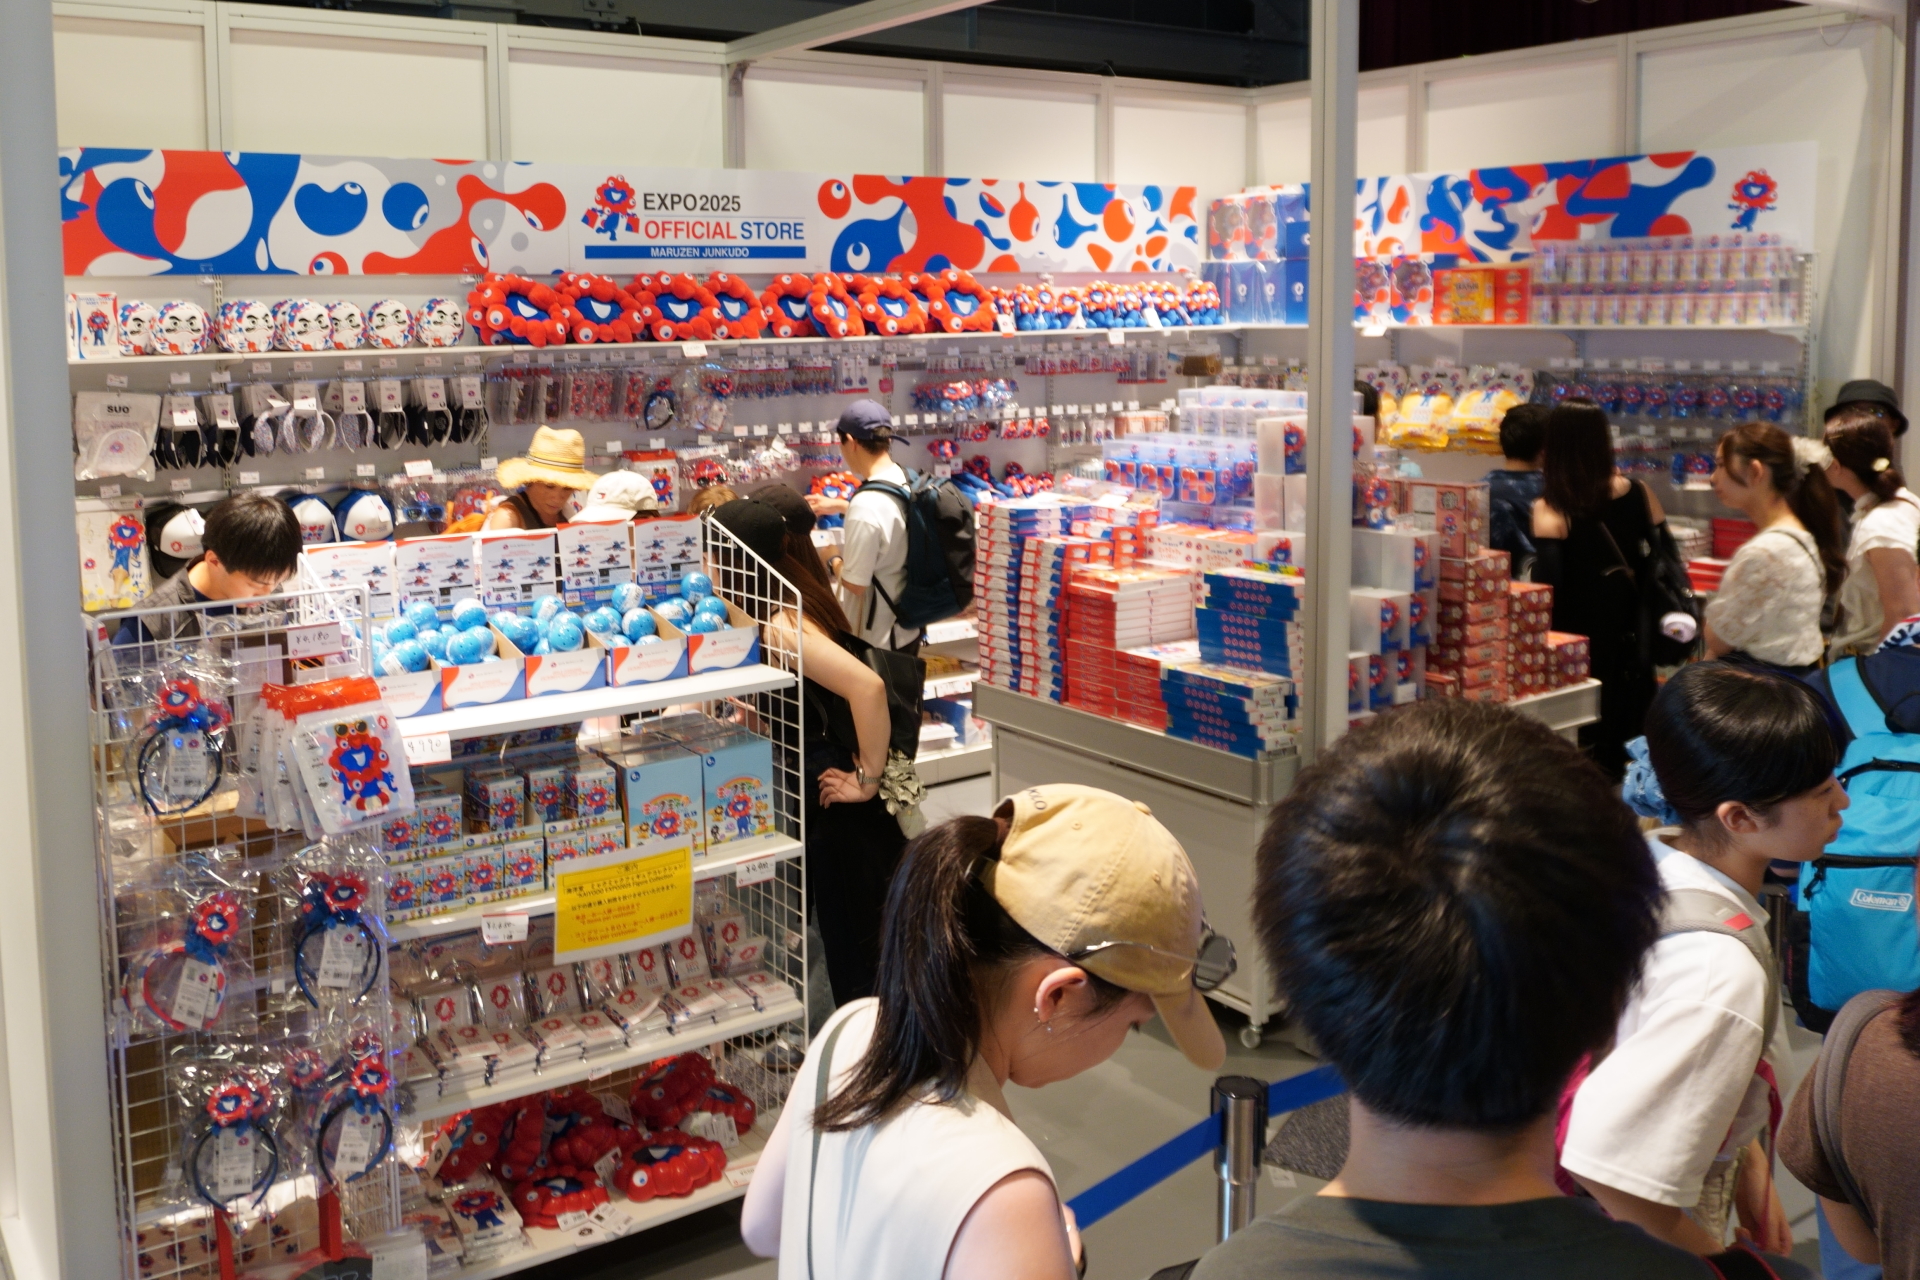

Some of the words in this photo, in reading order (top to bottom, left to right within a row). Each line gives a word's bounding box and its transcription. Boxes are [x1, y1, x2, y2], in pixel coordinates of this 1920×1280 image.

[644, 220, 737, 239] OFFICIAL
[740, 221, 805, 240] STORE
[650, 247, 700, 258] MARUZEN
[702, 247, 750, 258] JUNKUDO
[1856, 892, 1898, 906] Coleman
